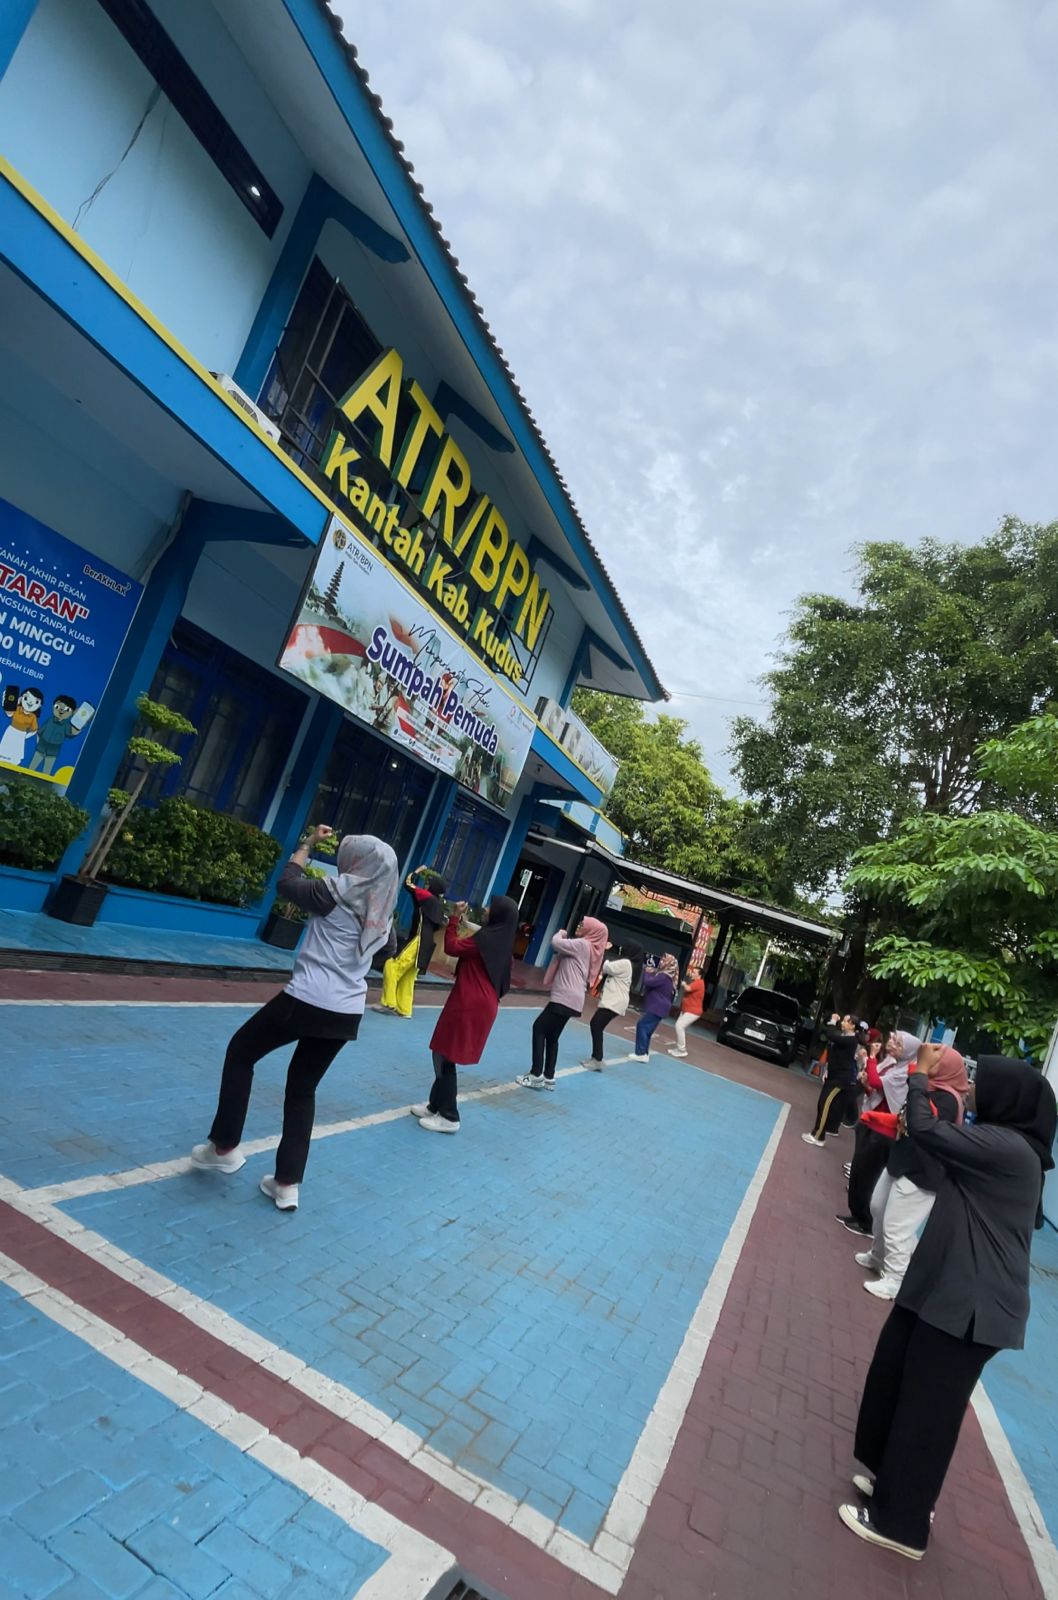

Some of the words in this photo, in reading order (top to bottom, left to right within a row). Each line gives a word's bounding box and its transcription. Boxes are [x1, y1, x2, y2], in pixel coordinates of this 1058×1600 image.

[340, 348, 550, 650] ATR/BPN
[0, 547, 28, 569] ANAH
[28, 566, 57, 585] AKHIR
[58, 581, 87, 602] PEKAN
[324, 432, 426, 574] Kantah
[428, 555, 471, 631] Kab.
[473, 608, 523, 681] Kudus
[347, 543, 374, 572] ATR/BPN
[83, 564, 128, 597] BerAKHLAK
[9, 615, 75, 656] MINGGU
[40, 614, 67, 633] TANPA
[68, 628, 95, 648] KUASA
[18, 641, 52, 667] WIB
[22, 667, 45, 680] LIBUR
[367, 627, 443, 710] Sumpah
[444, 689, 499, 756] Pemuda
